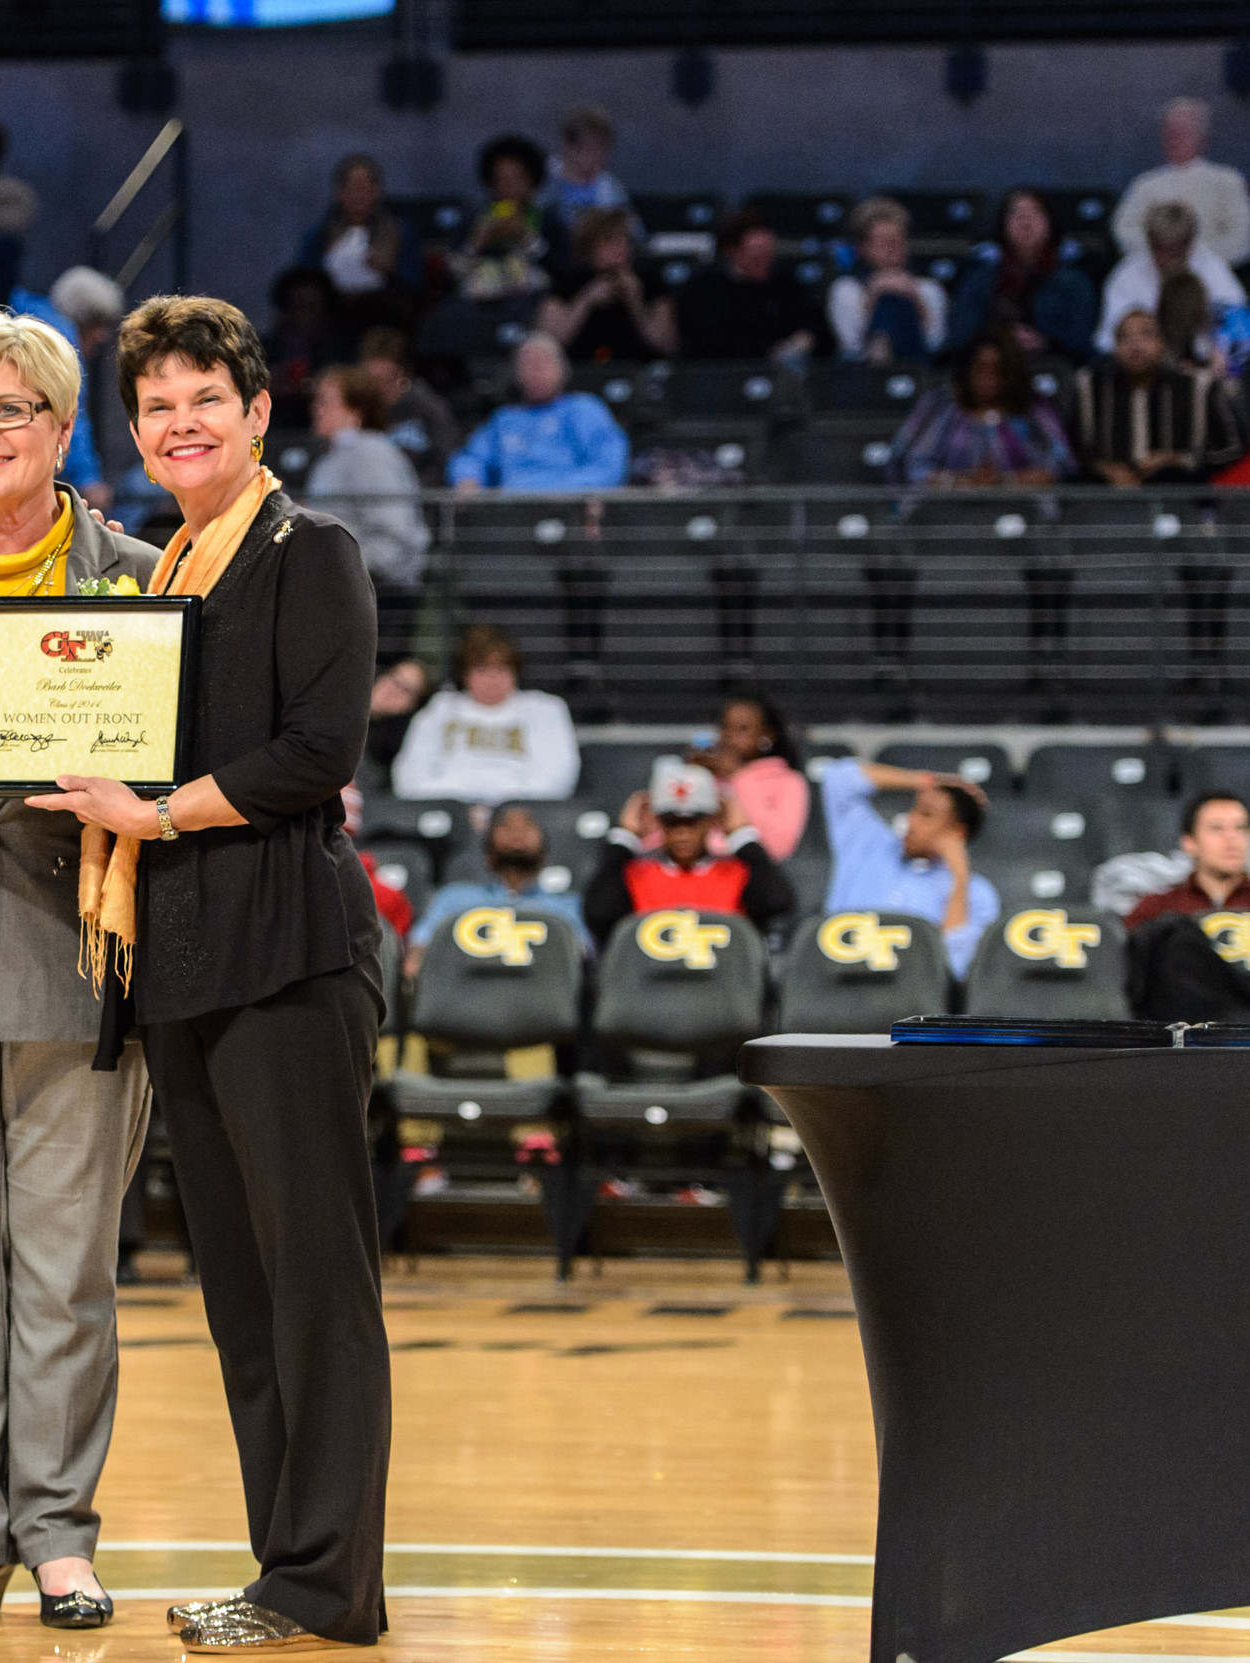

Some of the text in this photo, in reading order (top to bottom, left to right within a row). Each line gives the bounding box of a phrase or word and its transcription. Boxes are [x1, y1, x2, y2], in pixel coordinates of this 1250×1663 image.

[40, 631, 86, 661] GT
[36, 678, 67, 691] Barb
[49, 698, 68, 708] Class
[77, 699, 102, 709] 2014
[3, 713, 143, 724] WOMEN OUT FRONT
[453, 906, 547, 966] GT
[636, 910, 731, 970] GT
[817, 911, 912, 971] GT
[1004, 909, 1101, 969] GT
